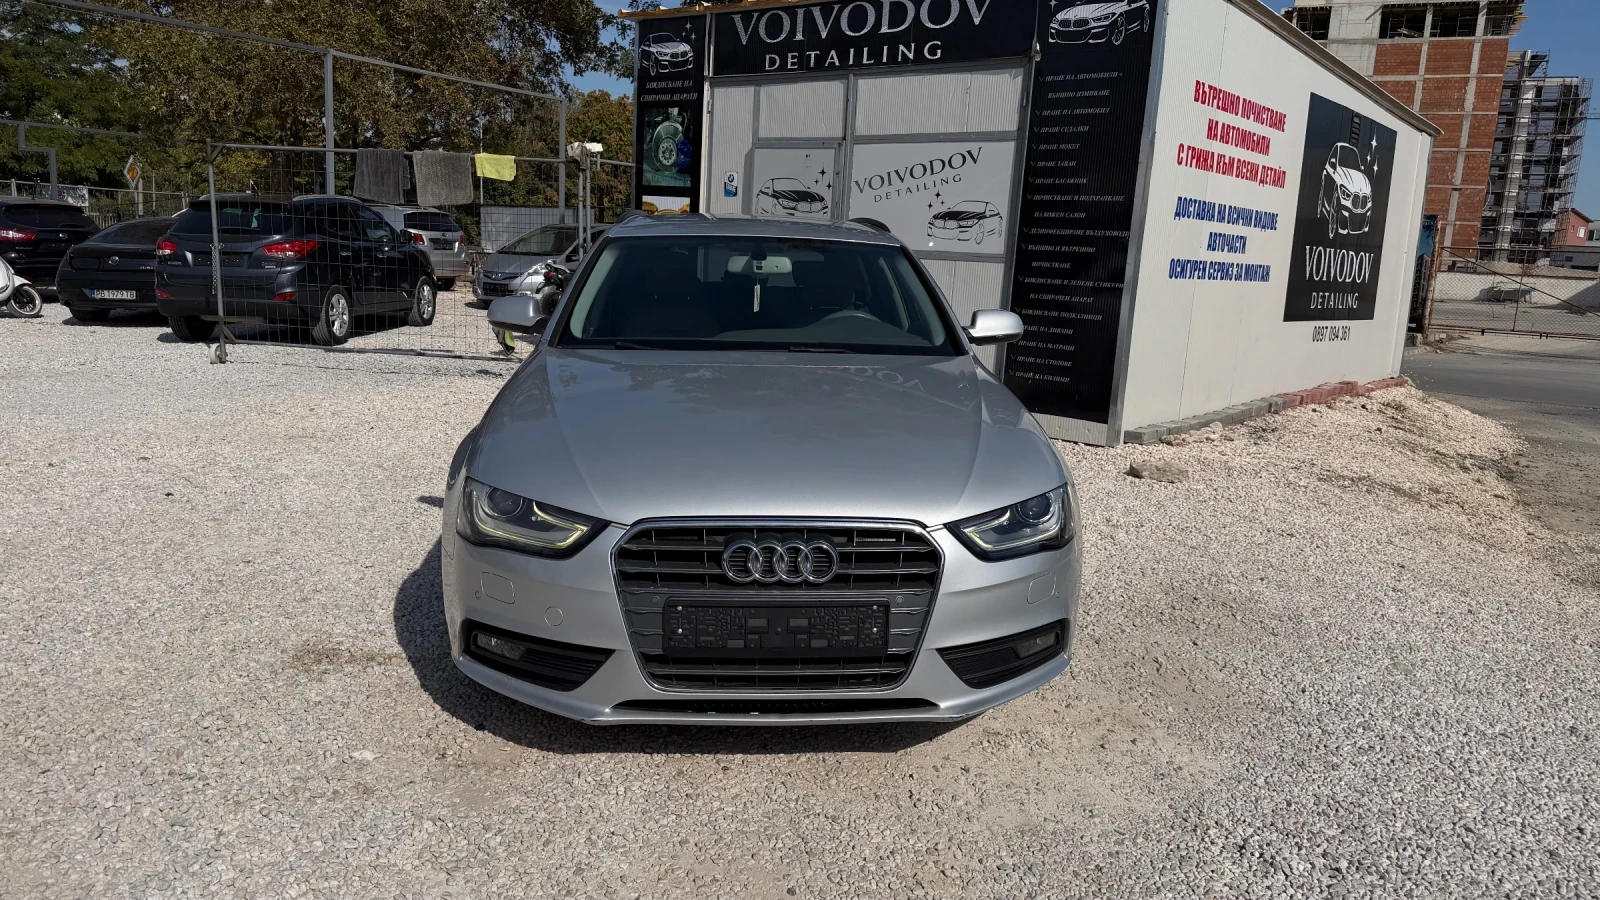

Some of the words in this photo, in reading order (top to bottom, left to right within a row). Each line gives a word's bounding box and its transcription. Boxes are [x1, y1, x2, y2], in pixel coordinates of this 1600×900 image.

[731, 0, 990, 46] VOIVODOV
[765, 41, 942, 70] DETAILING
[1075, 71, 1118, 80] АВТОМОБИЛИ
[1194, 79, 1240, 117] ВЪТРЕШНО
[1241, 97, 1287, 133] ПОЧИСТВАНЕ
[1206, 118, 1219, 142] НА
[1219, 122, 1271, 156] АВТОМОБИЛИ
[854, 146, 982, 194] VOIVODOV
[1176, 143, 1184, 166] С
[1185, 145, 1215, 173] ГРИЖА
[1215, 153, 1235, 177] КЪМ
[1235, 158, 1260, 183] ВСЕКИ
[1258, 164, 1287, 189] ДЕТАЙЛ
[874, 174, 962, 203] DETAILING
[1174, 196, 1216, 222] ДОСТАВКА
[1216, 203, 1226, 224] НА
[1226, 205, 1254, 228] ВСИЧКИ
[1253, 209, 1278, 232] ВИДОВЕ
[1206, 231, 1247, 254] АВТОЧАСТИ
[1168, 258, 1208, 280] ОСИГУРЕН
[1207, 260, 1235, 281] СЕРВИЗ
[1234, 262, 1243, 282] ЗА
[1243, 263, 1271, 283] МОНТАЖ
[1305, 245, 1374, 284] VOIVODOV
[107, 290, 124, 298] 1979
[1310, 291, 1359, 309] DETAILING
[1312, 325, 1328, 342] 0897
[1328, 325, 1340, 342] 094
[1340, 325, 1351, 341] 361
